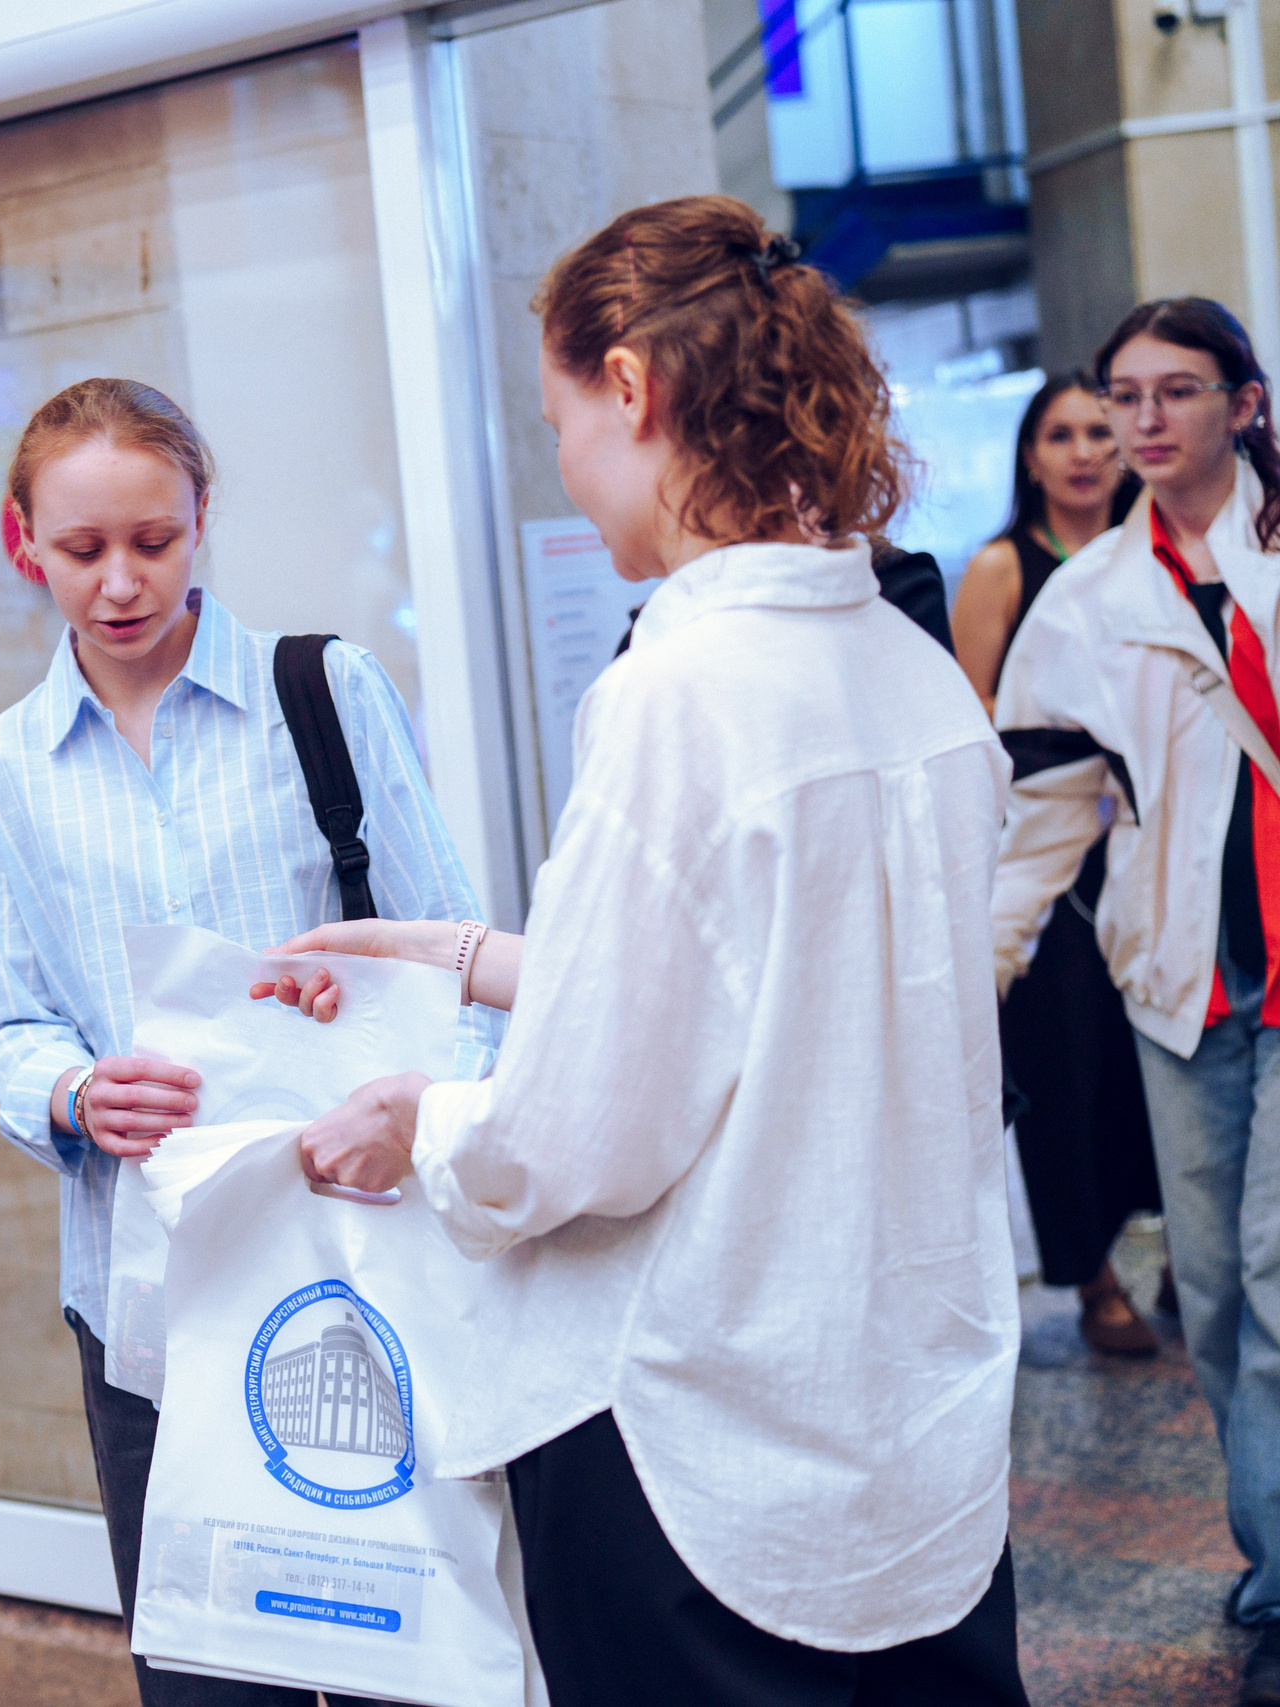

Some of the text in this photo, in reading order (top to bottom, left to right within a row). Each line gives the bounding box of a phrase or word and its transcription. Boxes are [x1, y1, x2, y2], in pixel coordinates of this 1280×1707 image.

[257, 1285, 323, 1347] ГОСУДАРСТВЕННЫЙ
[249, 1347, 277, 1452] САНКТ-ПЕТЕРБУРГСКИЙ
[281, 1469, 400, 1505] ТРАДИЦИИ И СТАБИЛЬНОСТЬ
[203, 1517, 235, 1529] ВЕДУЩИЙ
[236, 1522, 249, 1532] ВУЗ
[250, 1524, 256, 1532] В
[256, 1524, 286, 1536] ОБЛАСТИ
[287, 1528, 327, 1542] ЦИФРОВОГО
[327, 1534, 360, 1546] ДИЗАЙНА
[360, 1539, 366, 1547] И
[367, 1540, 427, 1555] ПРОМЫШЛЕННЫХ
[256, 1543, 283, 1556] Россия,
[283, 1547, 340, 1565] Санкт-Петербург,
[341, 1557, 352, 1566] ул.
[353, 1557, 384, 1570] Большая
[428, 1568, 436, 1577] 18
[307, 1574, 329, 1588] (812)
[331, 1577, 376, 1594] 317-14-14
[270, 1599, 386, 1625] www.prouniver.ru www.sutd.ru
